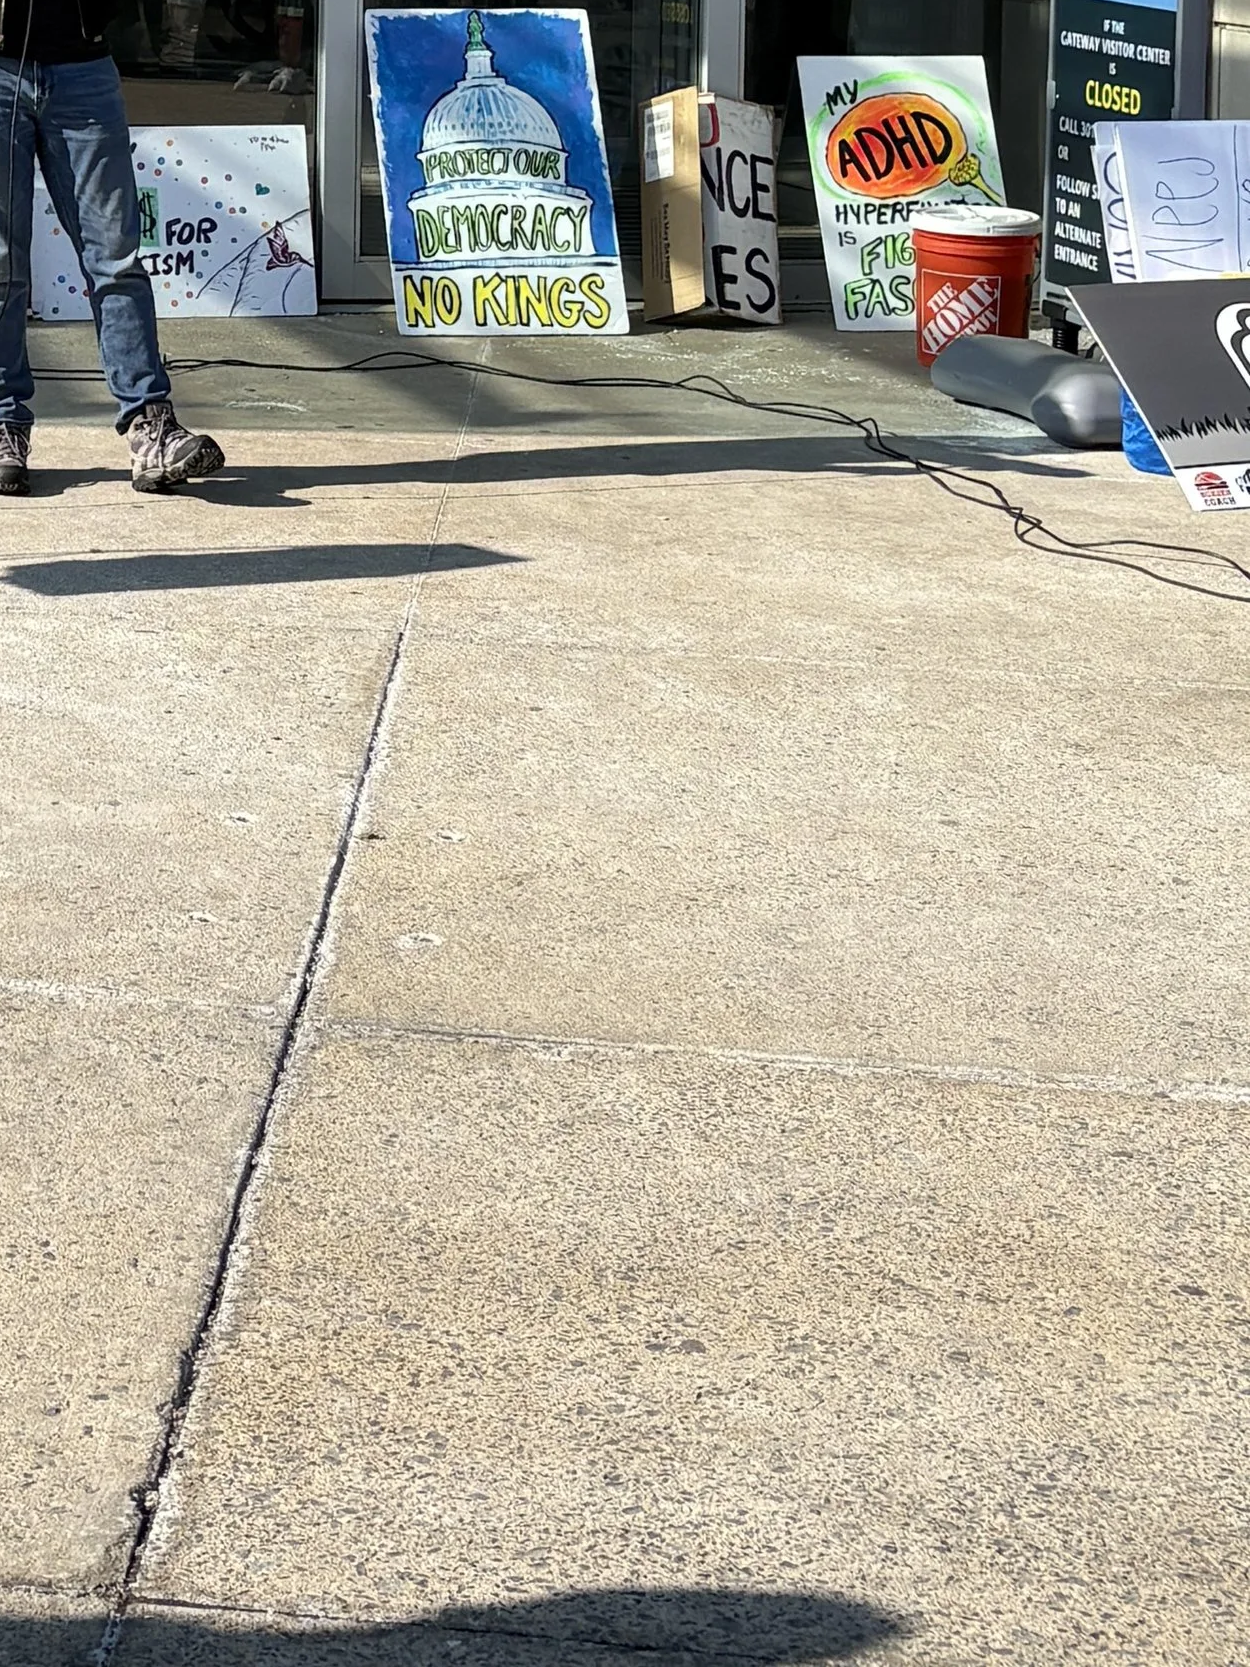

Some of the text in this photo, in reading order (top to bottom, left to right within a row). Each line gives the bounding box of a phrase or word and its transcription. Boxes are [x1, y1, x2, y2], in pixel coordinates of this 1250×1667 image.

[1103, 19, 1125, 34] IF THE
[1060, 31, 1170, 66] GATEWAY VISITOR CENTER
[1109, 62, 1116, 75] IS
[826, 79, 858, 115] MY
[1085, 79, 1141, 115] CLOSED
[1059, 116, 1079, 135] CALL
[838, 111, 953, 182] ADHD
[1058, 145, 1069, 161] OR
[425, 148, 561, 182] PROTECT OUR
[1056, 174, 1090, 197] FOLLOW
[1055, 197, 1081, 219] TO AN
[165, 217, 217, 246] FOR
[416, 203, 588, 259] DEMOCRACY
[839, 231, 857, 247] IS
[1054, 221, 1101, 249] ALTERNATE
[1054, 244, 1098, 272] ENTRANCE
[403, 272, 611, 329] NO KINGS
[844, 275, 917, 320] FAS
[926, 282, 958, 314] THE
[923, 275, 998, 352] HOME
